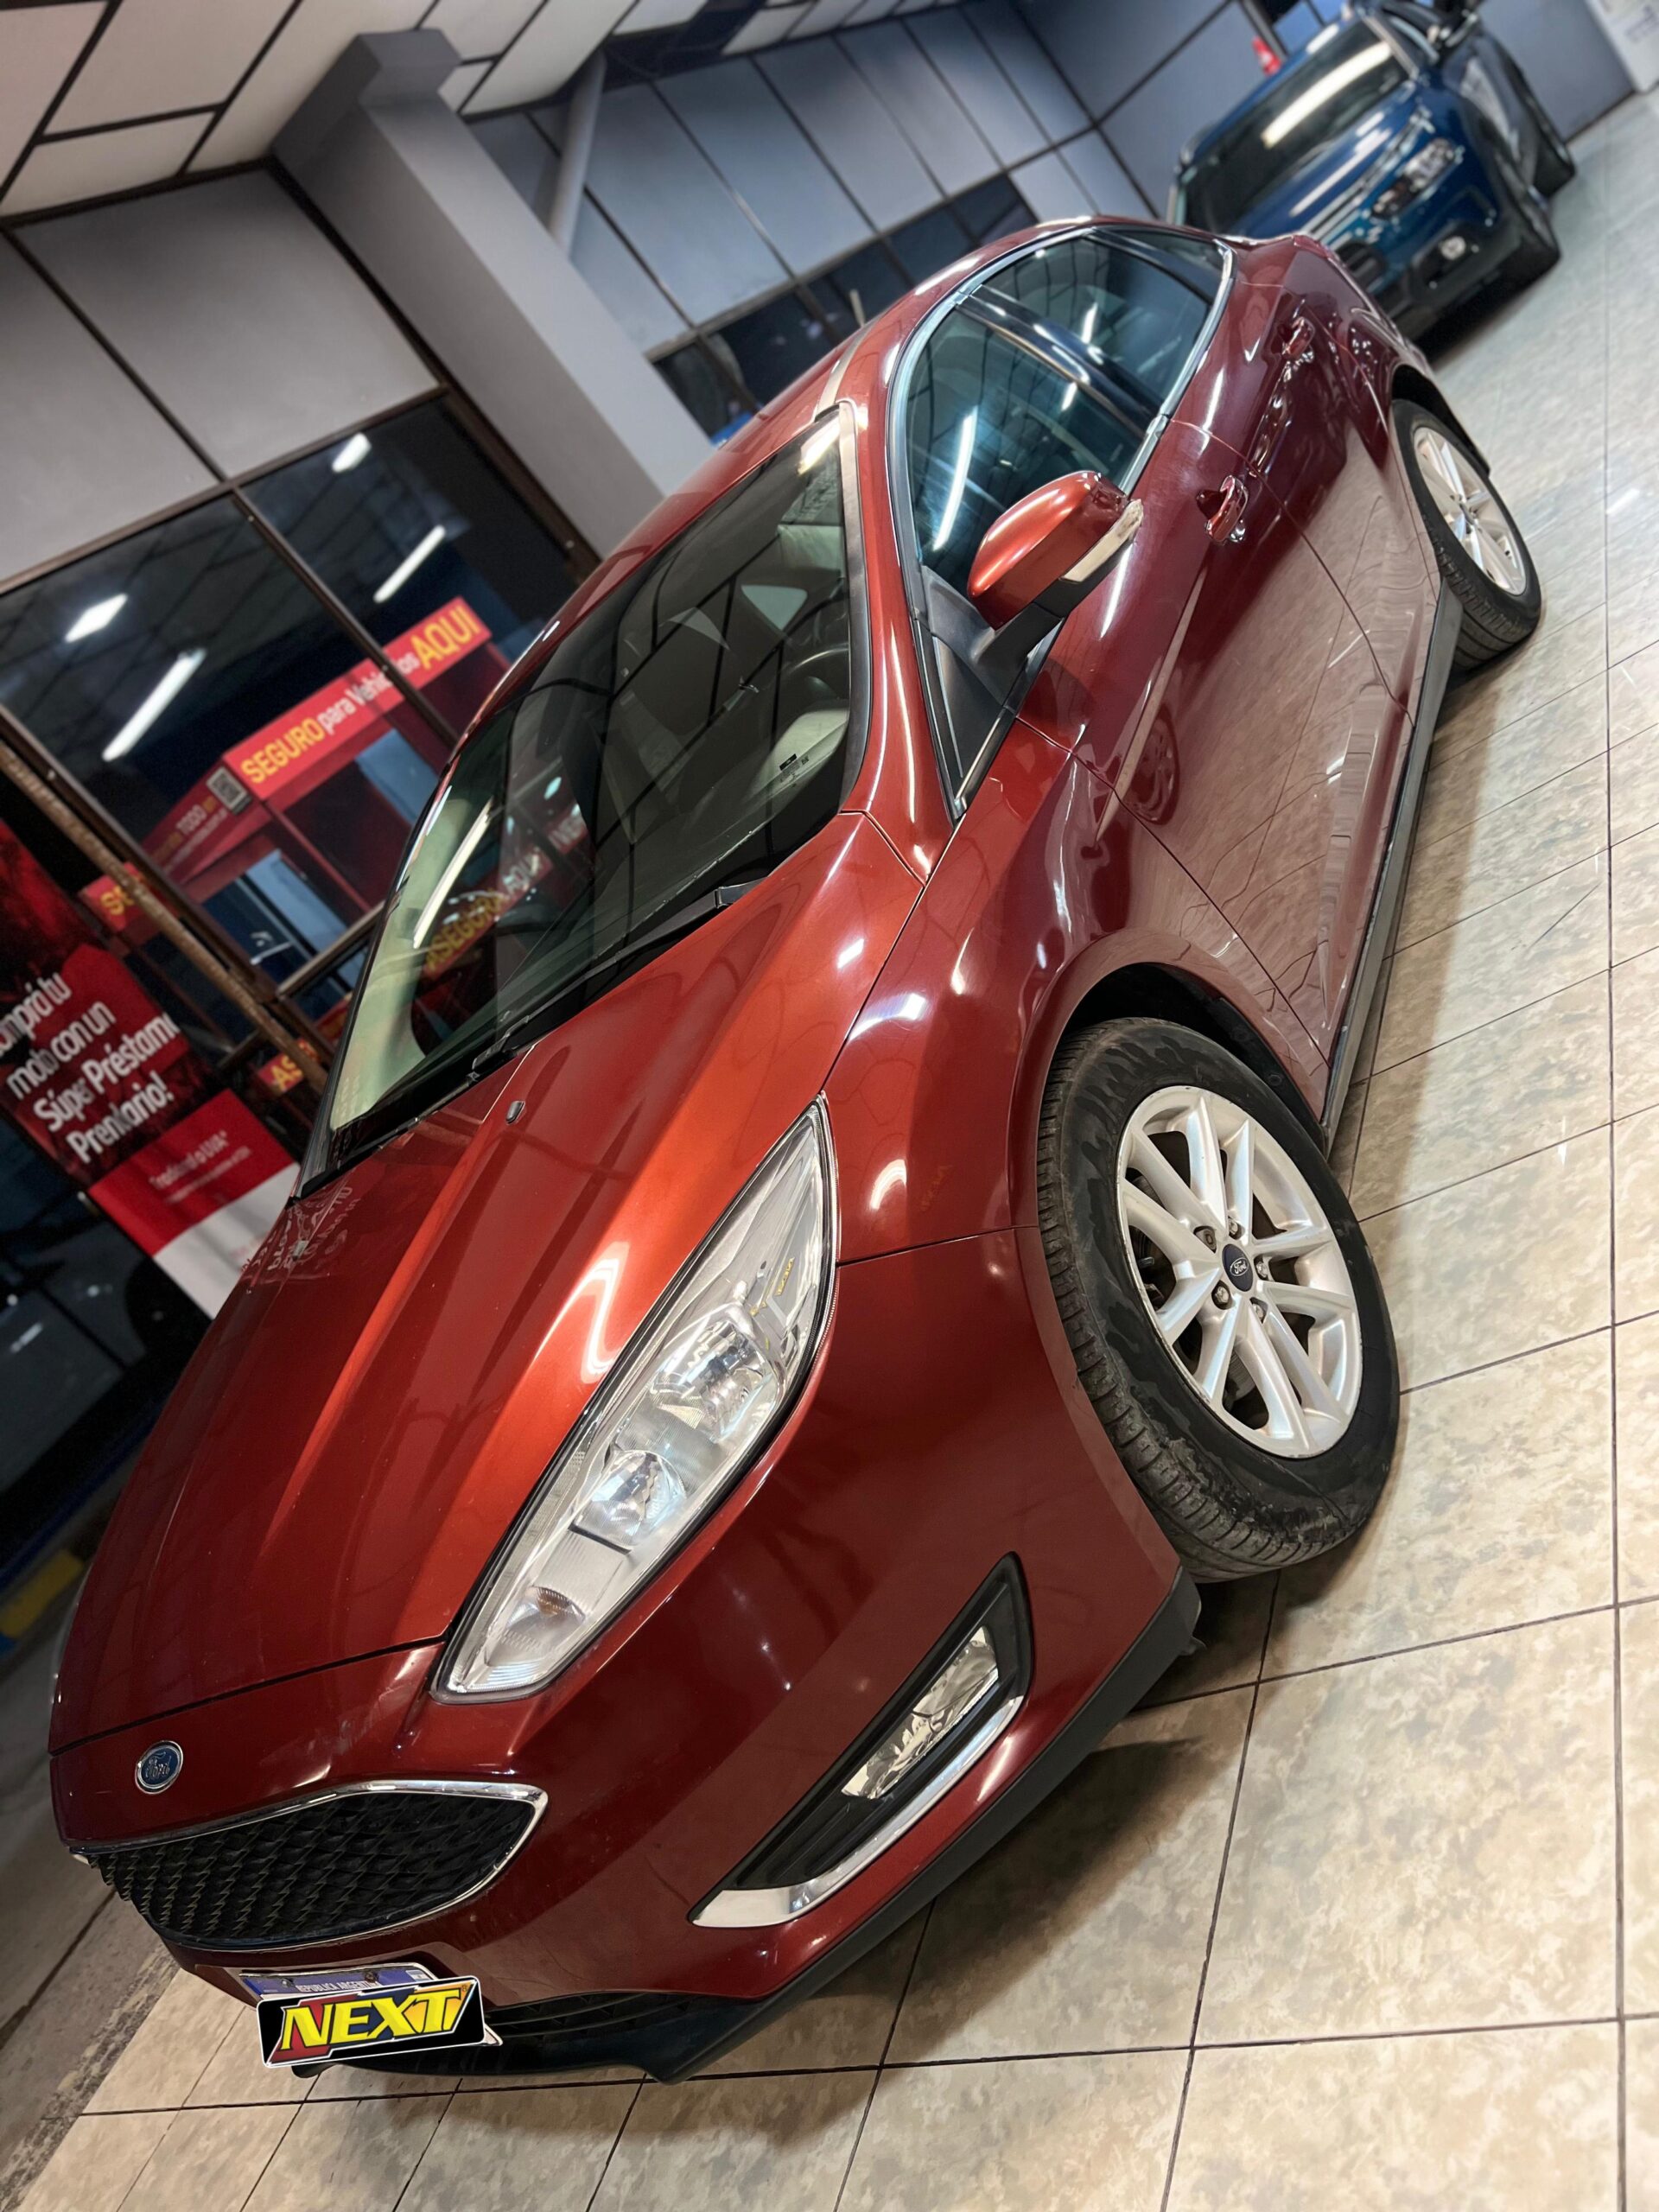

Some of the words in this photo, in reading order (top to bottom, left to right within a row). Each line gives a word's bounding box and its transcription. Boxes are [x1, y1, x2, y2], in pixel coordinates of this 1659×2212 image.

[241, 718, 325, 783] SEGURO
[317, 696, 356, 735] para
[410, 605, 480, 670] AQUI
[36, 972, 73, 1006] tu
[50, 1014, 94, 1062] con
[82, 1001, 116, 1036] un
[145, 1751, 172, 1780] Ford
